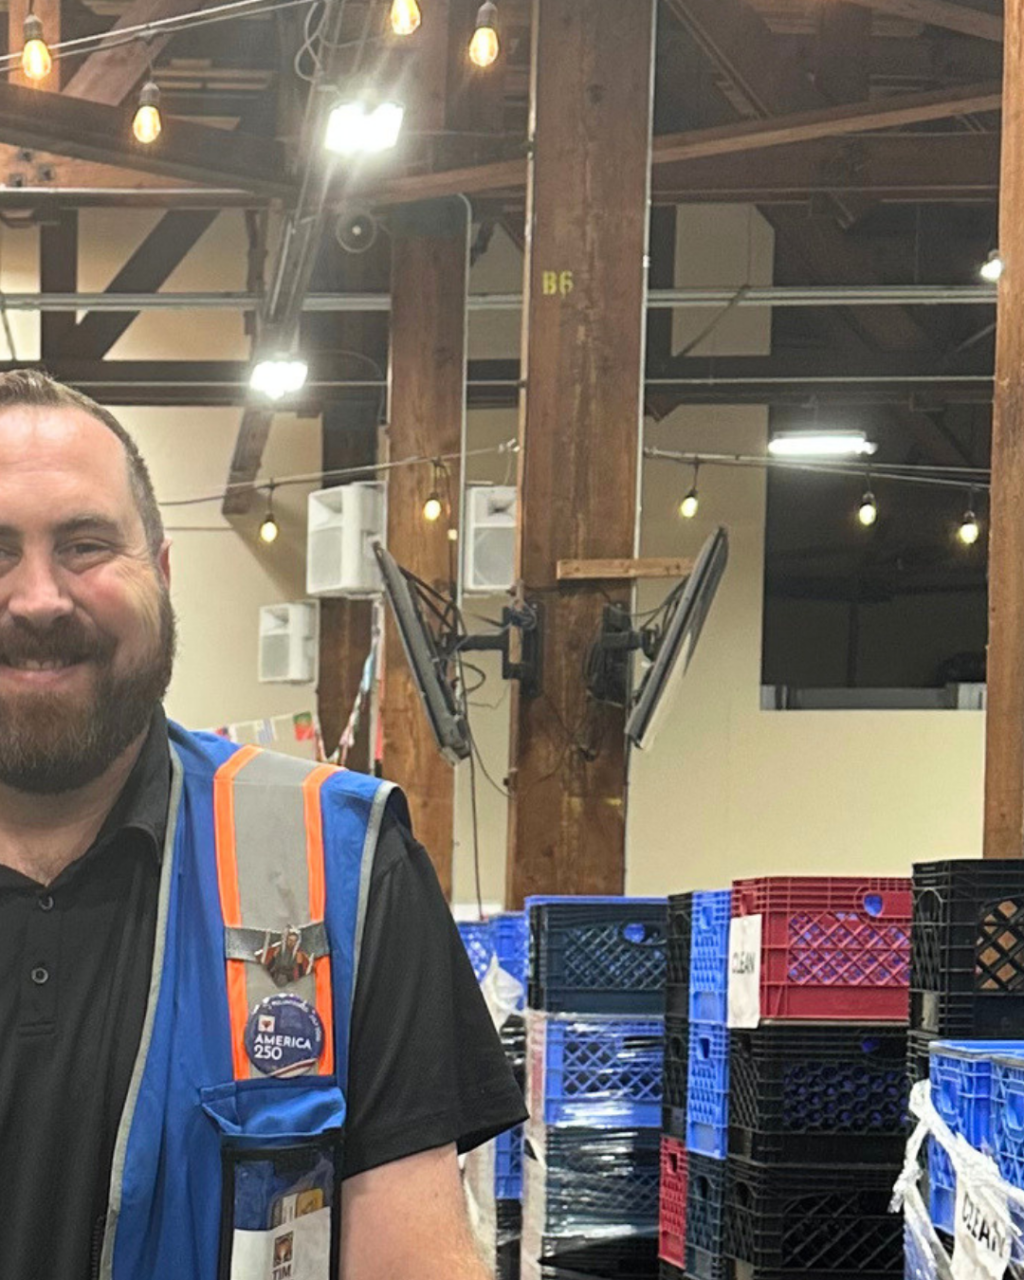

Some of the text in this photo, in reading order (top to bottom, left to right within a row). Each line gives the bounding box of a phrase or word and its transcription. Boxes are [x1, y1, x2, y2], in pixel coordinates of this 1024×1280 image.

[542, 270, 574, 298] B6
[253, 1033, 312, 1050] AMERICA
[253, 1044, 283, 1060] 250
